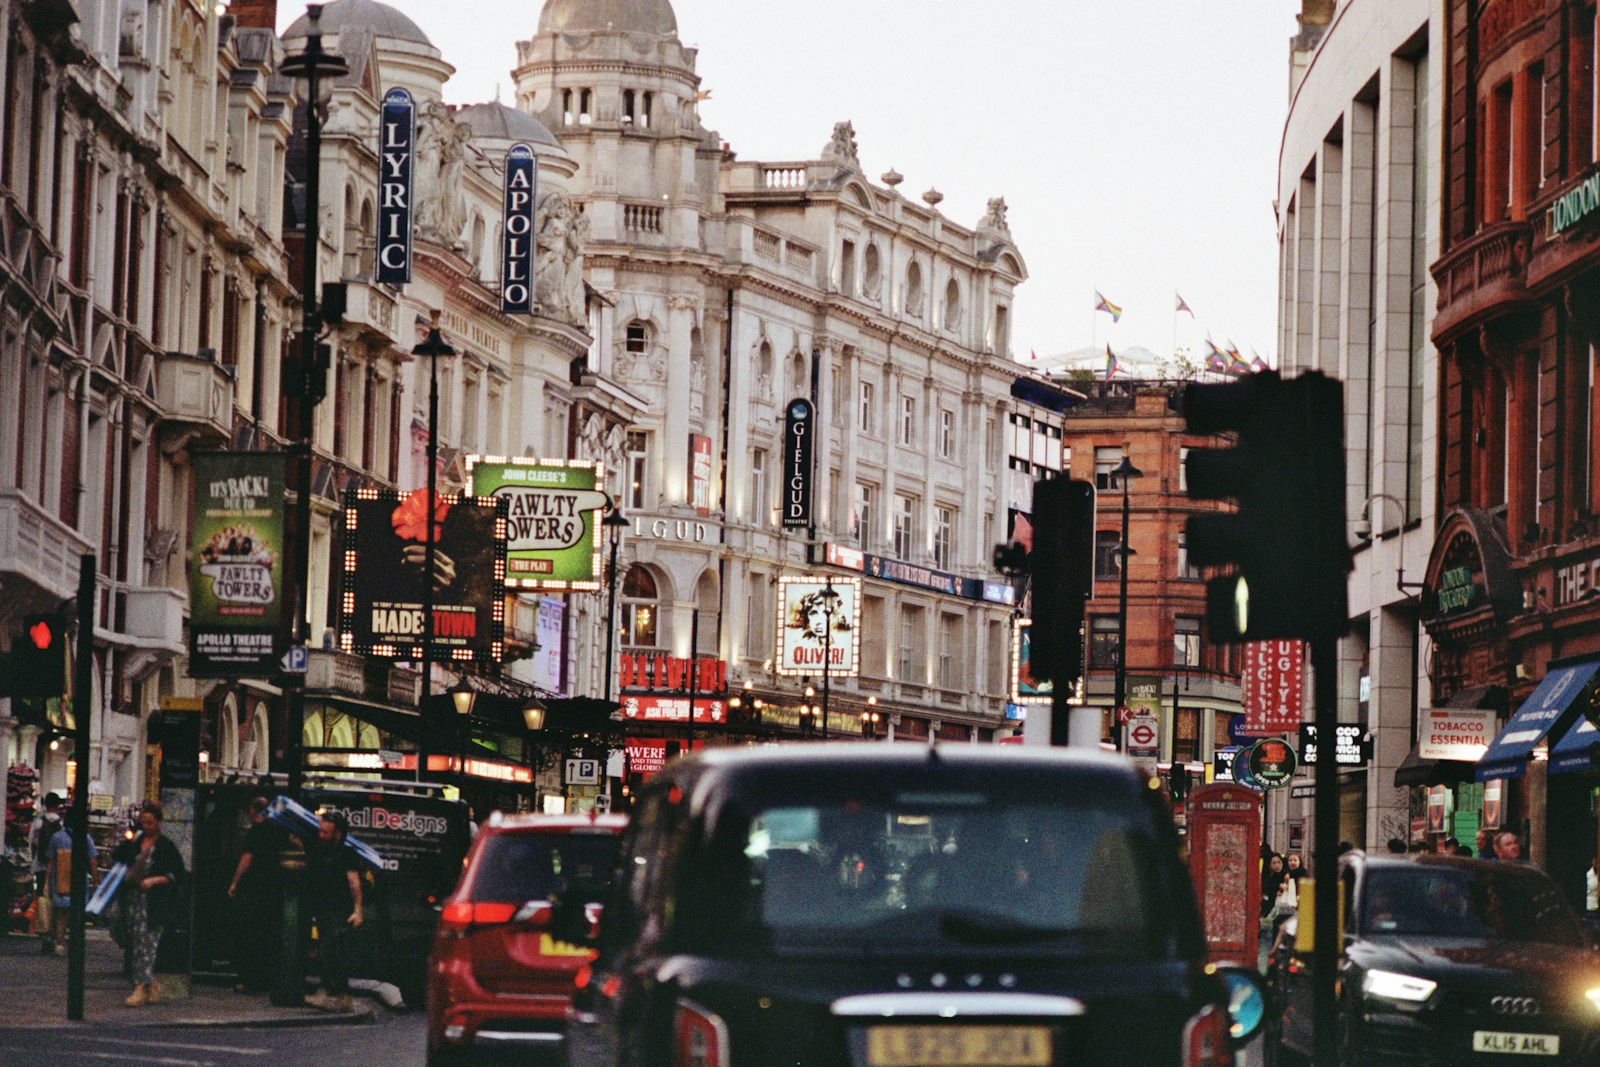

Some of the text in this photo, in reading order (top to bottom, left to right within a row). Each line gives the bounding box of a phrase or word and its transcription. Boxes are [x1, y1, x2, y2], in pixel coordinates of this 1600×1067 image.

[381, 123, 407, 269] LYRIC
[1553, 172, 1600, 233] LONDON
[505, 169, 530, 303] APOLLO
[502, 469, 567, 483] JOHN CLEESE'S
[791, 422, 805, 517] GIELGUD
[228, 475, 268, 497] BACK!
[507, 518, 575, 544] OWERS
[220, 567, 263, 580] FAWLTY
[515, 561, 547, 571] THE PLAY
[217, 581, 271, 600] TOWERS
[1558, 563, 1586, 603] THE
[197, 634, 273, 646] APOLLO THEATRE
[292, 650, 304, 668] P
[1278, 641, 1291, 702] UGLY
[1121, 709, 1129, 721] K
[1433, 721, 1484, 731] TOBACCO
[1431, 734, 1487, 746] ESSENTIAL
[582, 762, 592, 775] P
[372, 807, 447, 836] Designs
[1522, 1037, 1551, 1053] AHL
